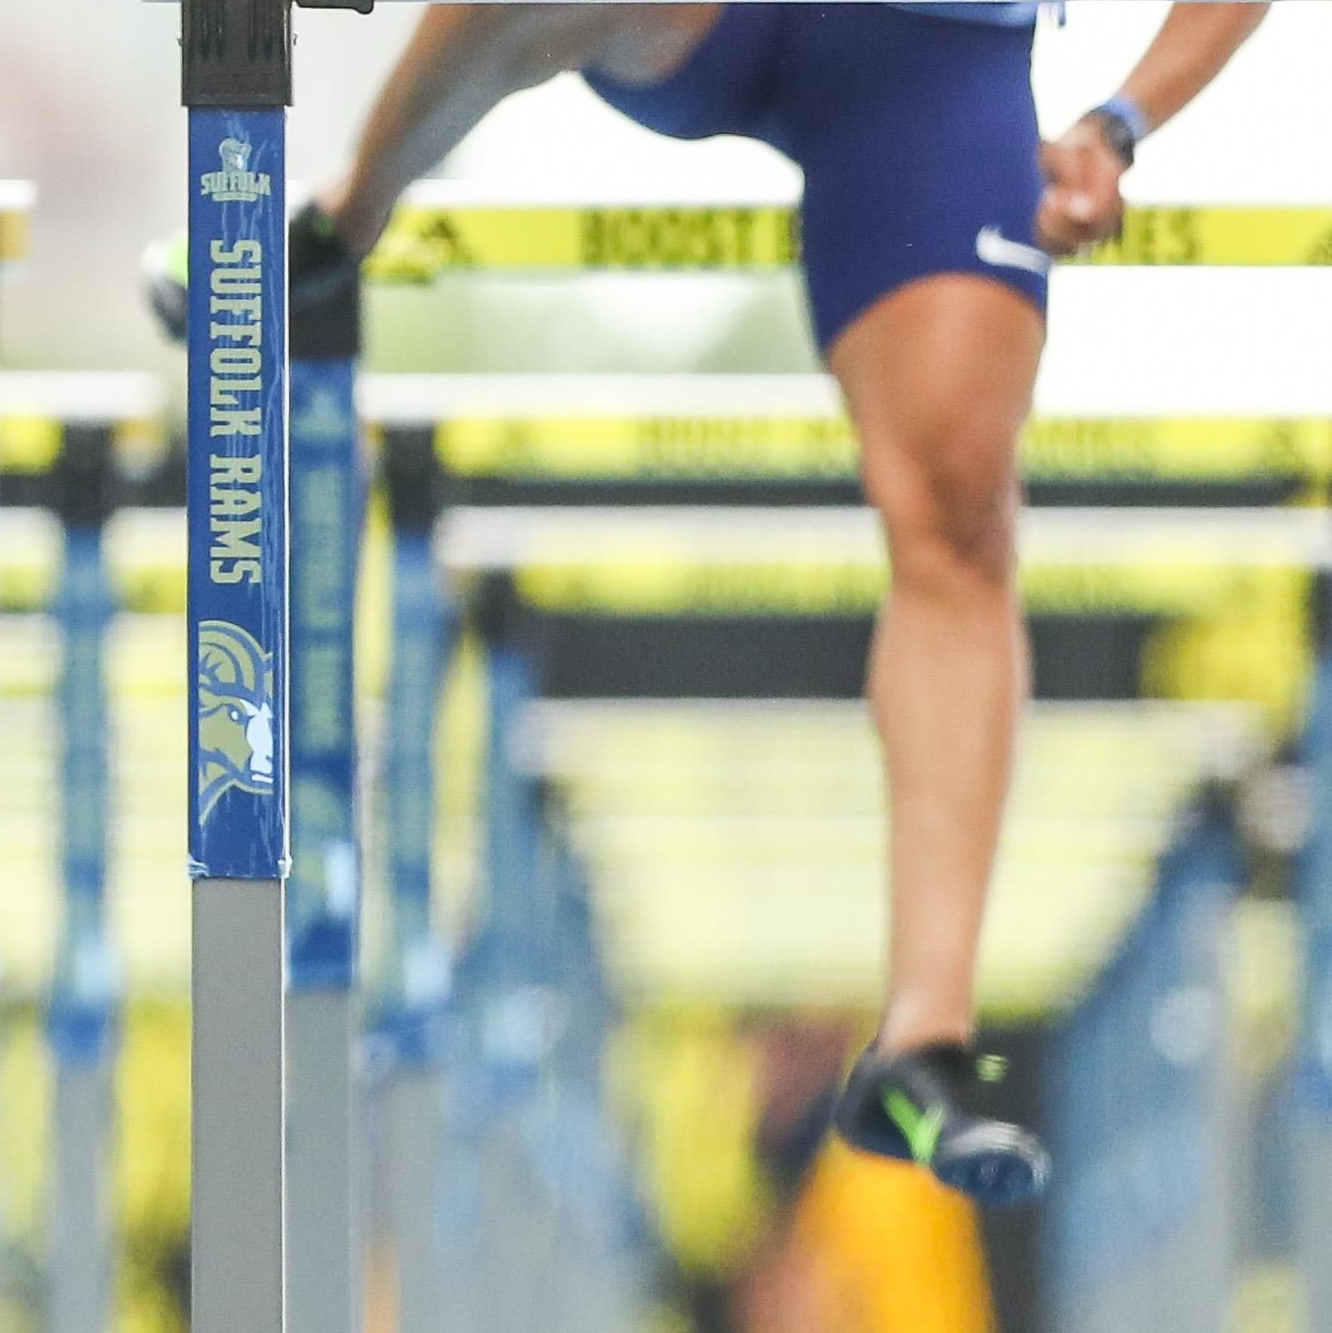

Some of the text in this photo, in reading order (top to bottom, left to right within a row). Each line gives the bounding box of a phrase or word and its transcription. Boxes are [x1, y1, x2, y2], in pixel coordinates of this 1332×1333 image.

[581, 207, 754, 266] BOOST
[209, 239, 264, 437] SUFFOLK
[209, 454, 264, 585] RAMS
